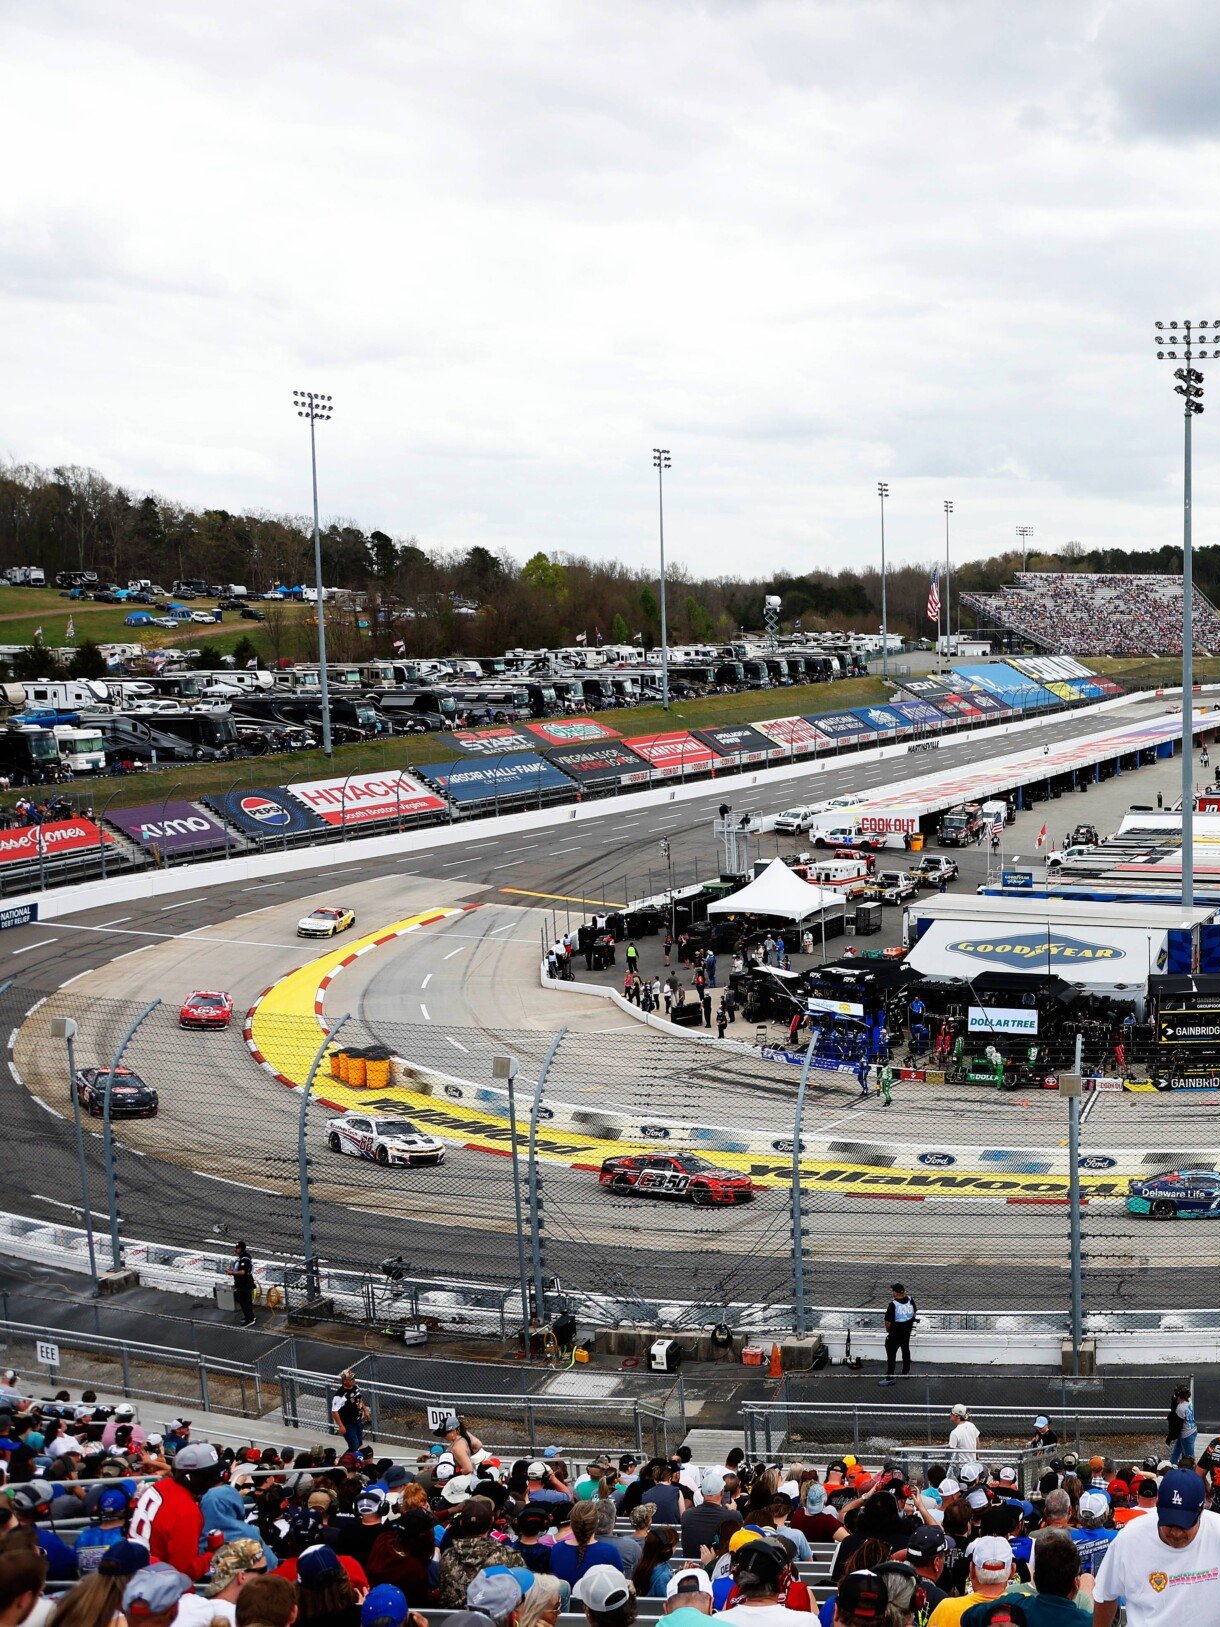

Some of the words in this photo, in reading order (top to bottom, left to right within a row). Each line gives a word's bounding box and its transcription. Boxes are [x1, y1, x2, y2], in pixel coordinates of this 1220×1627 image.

[459, 735, 527, 751] START
[642, 741, 702, 758] CRAFTSMAN
[907, 741, 940, 753] MARTINSVILLE
[449, 771, 485, 783] NASCAR
[487, 768, 511, 779] HALL
[517, 762, 548, 774] FAME
[301, 778, 417, 806] HITACHI
[249, 805, 285, 816] PEPSI
[340, 809, 366, 820] South
[367, 805, 397, 816] Boston
[399, 801, 429, 813] Virginia
[130, 816, 211, 839] xumo
[861, 818, 891, 832] COOK
[894, 818, 916, 832] OUT
[28, 825, 86, 853] Jones
[0, 907, 31, 919] NATIONAL
[1, 919, 13, 928] DEBT
[14, 915, 30, 925] RELIEF
[957, 941, 1114, 959] GOODYEAR
[970, 1017, 1012, 1028] DOLLAR
[1012, 1019, 1036, 1029] TREE
[923, 1153, 951, 1166] Ford
[1085, 1156, 1111, 1169] Ford
[1143, 1188, 1186, 1199] Delaware
[1188, 1189, 1205, 1199] Life
[41, 1346, 56, 1361] EEE
[1172, 1490, 1183, 1505] LA
[130, 1485, 163, 1549] 8
